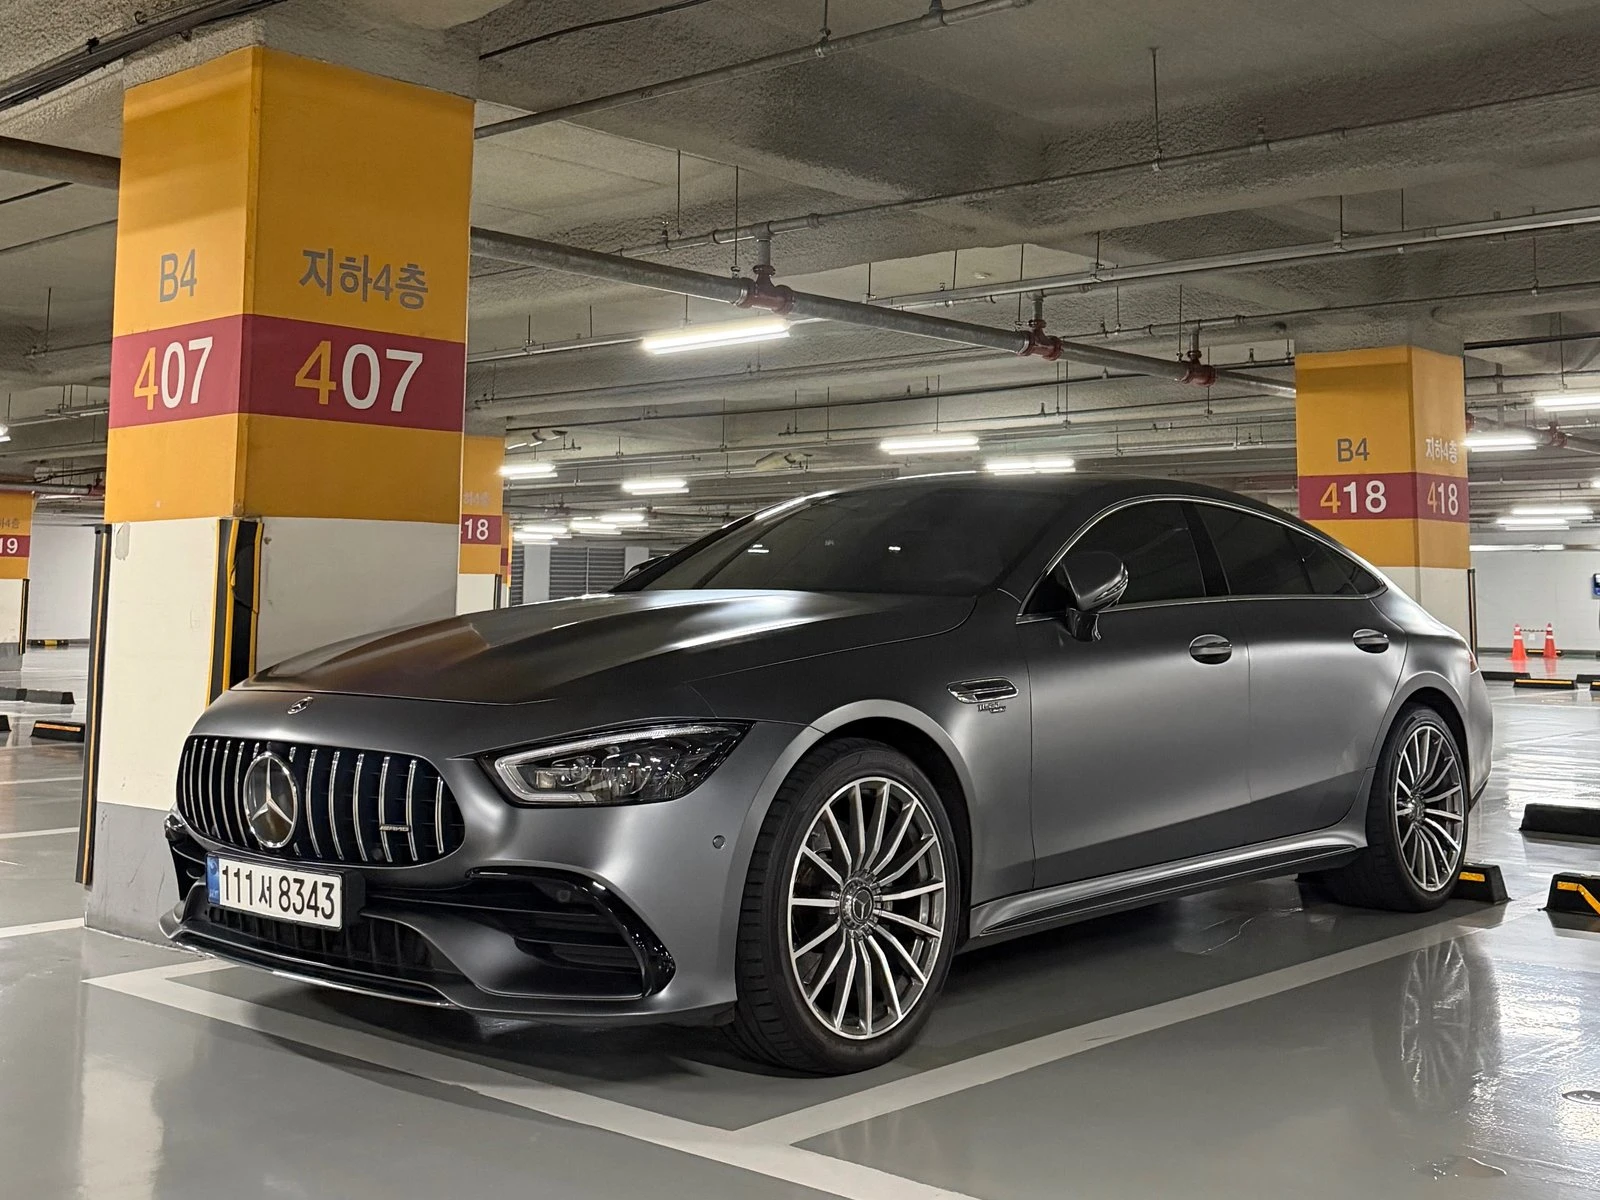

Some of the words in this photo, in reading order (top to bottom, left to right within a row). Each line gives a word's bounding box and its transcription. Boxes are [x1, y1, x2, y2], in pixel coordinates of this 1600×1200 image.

[159, 249, 198, 303] B4
[299, 247, 429, 311] 지하4층
[133, 336, 214, 411] 407
[294, 340, 423, 413] 407
[1336, 437, 1370, 463] B4
[1425, 436, 1458, 465] 지하4층
[1319, 479, 1387, 514] 418
[1427, 481, 1459, 516] 418
[461, 518, 489, 540] 18
